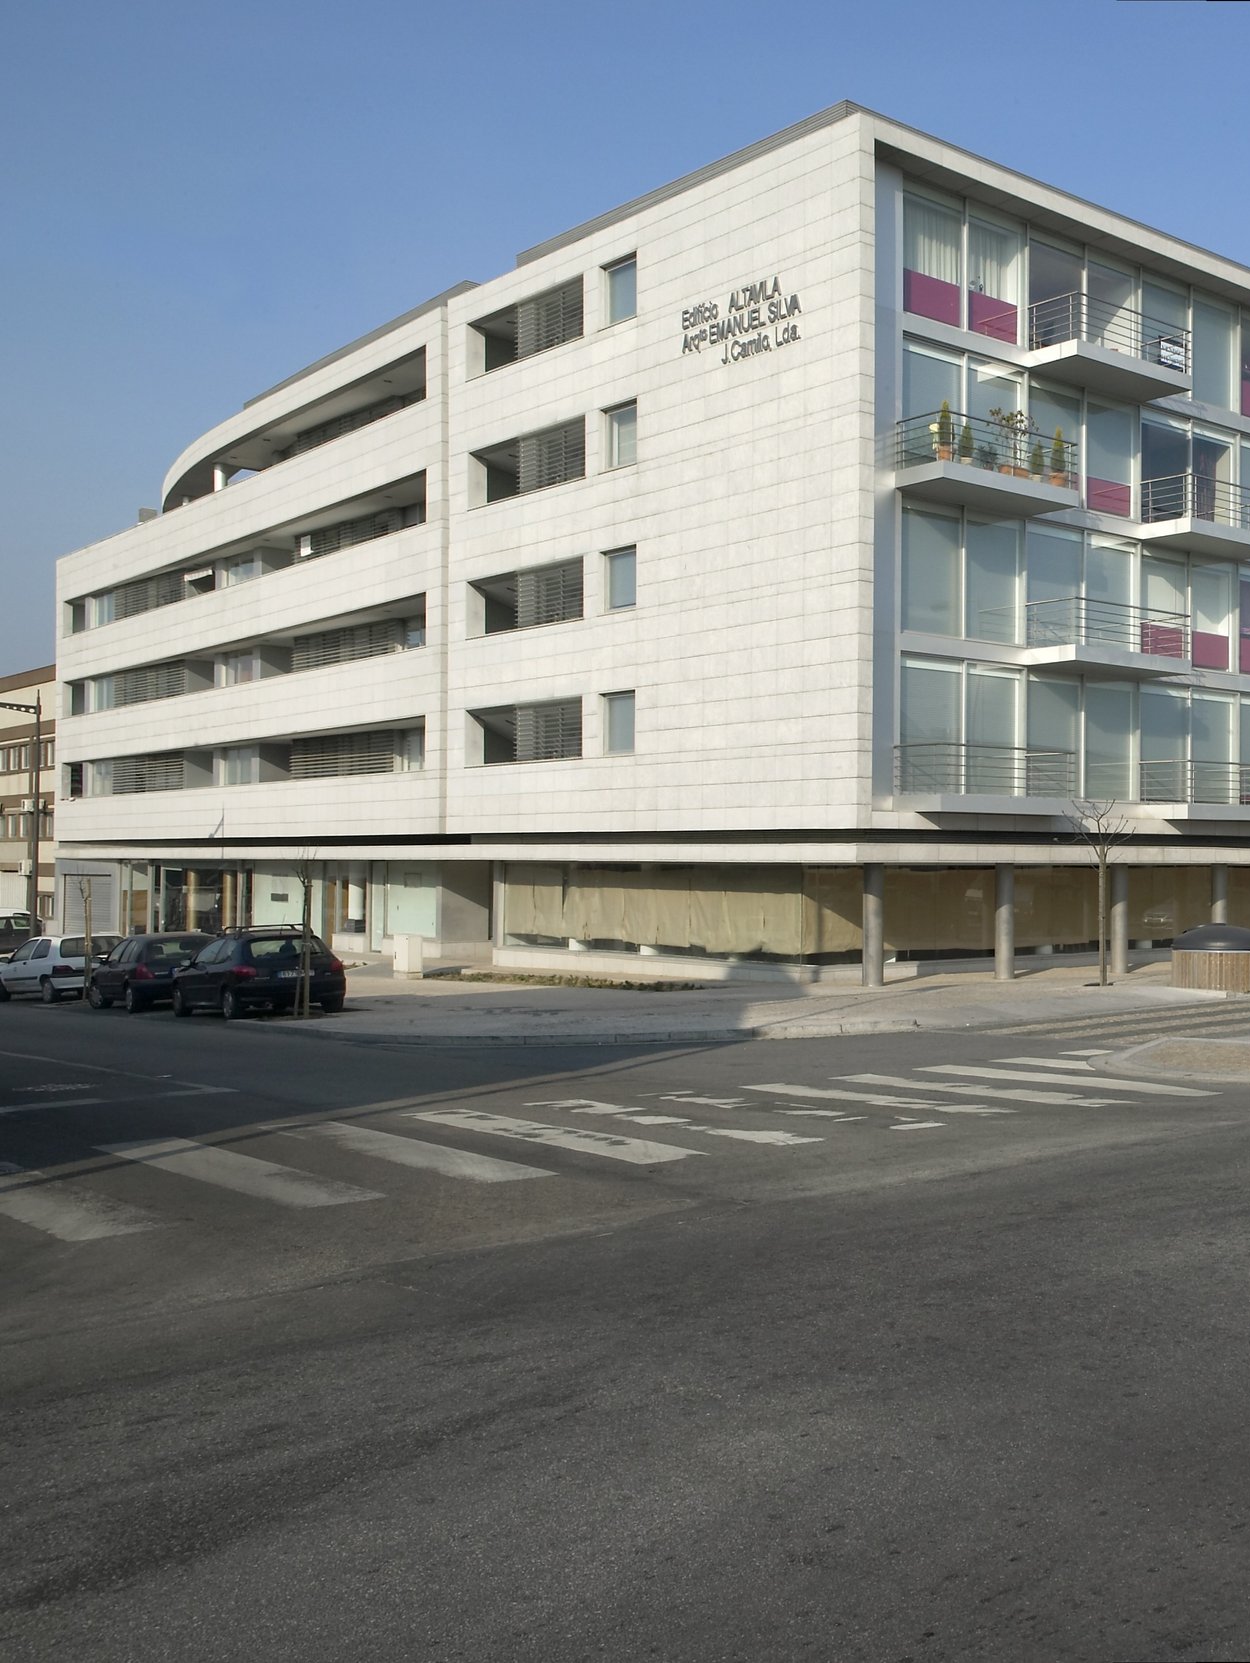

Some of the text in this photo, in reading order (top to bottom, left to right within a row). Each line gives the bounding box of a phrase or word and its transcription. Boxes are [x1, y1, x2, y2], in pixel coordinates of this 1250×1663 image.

[728, 276, 782, 313] ALTAVILA
[709, 307, 767, 345] EMANUEL
[768, 293, 802, 324] SILVA
